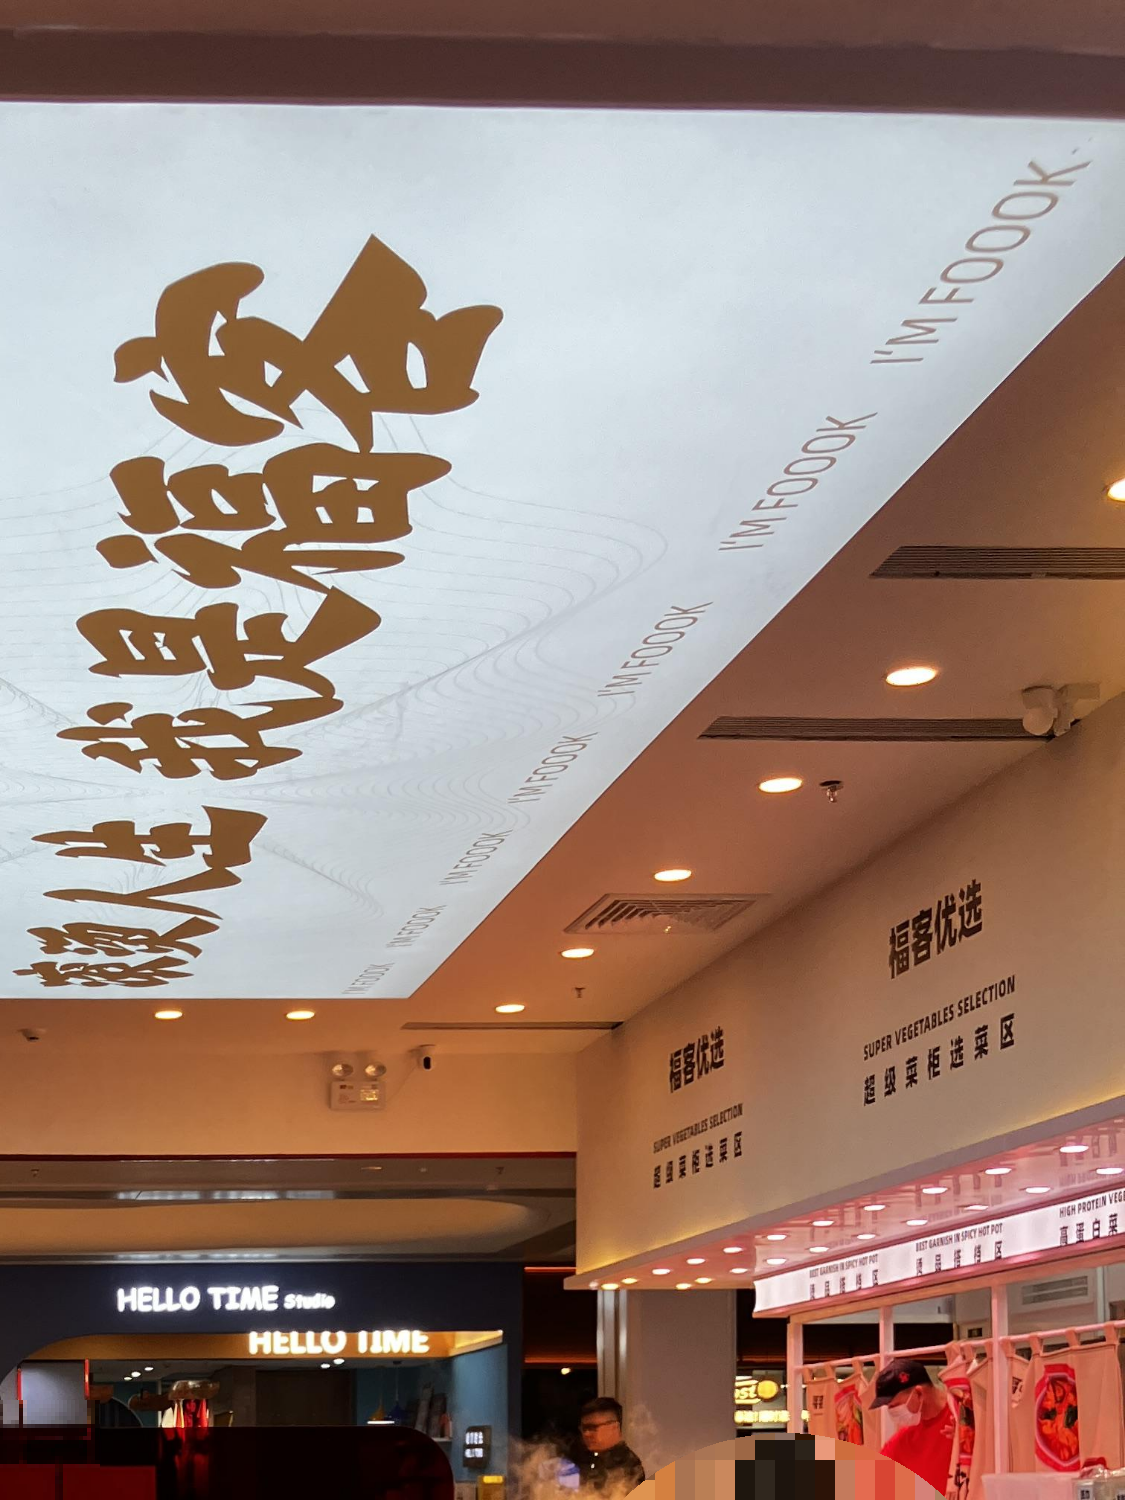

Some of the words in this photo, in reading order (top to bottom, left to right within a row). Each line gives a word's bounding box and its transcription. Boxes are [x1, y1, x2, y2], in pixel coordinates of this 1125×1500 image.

[870, 318, 957, 364] I'M
[918, 160, 1091, 305] FOOOK
[751, 412, 878, 511] FOOOK
[57, 234, 504, 780] 我是福客
[718, 517, 787, 551] I'M
[620, 602, 713, 669] FOOOK
[597, 672, 652, 697] I'M
[525, 732, 598, 783] FOOOK
[508, 784, 553, 803] I'M
[889, 879, 982, 979] 福客优选
[863, 1034, 892, 1061] SUPER
[895, 1004, 954, 1046] VEGETABLES
[957, 975, 1015, 1017] SELECTION
[669, 1026, 725, 1093] 福客优选
[863, 1013, 1015, 1106] 超级菜柜选菜区
[653, 1135, 671, 1154] SUPER
[672, 1118, 708, 1146] VEGETABLES
[709, 1103, 743, 1130] SELECTION
[1059, 1206, 1076, 1218] HIGH
[1078, 1195, 1107, 1213] PROTEIN
[117, 1286, 200, 1312] HELLO
[207, 1285, 279, 1311] TIME
[284, 1293, 336, 1309] Studio
[249, 1330, 347, 1354] HELLO
